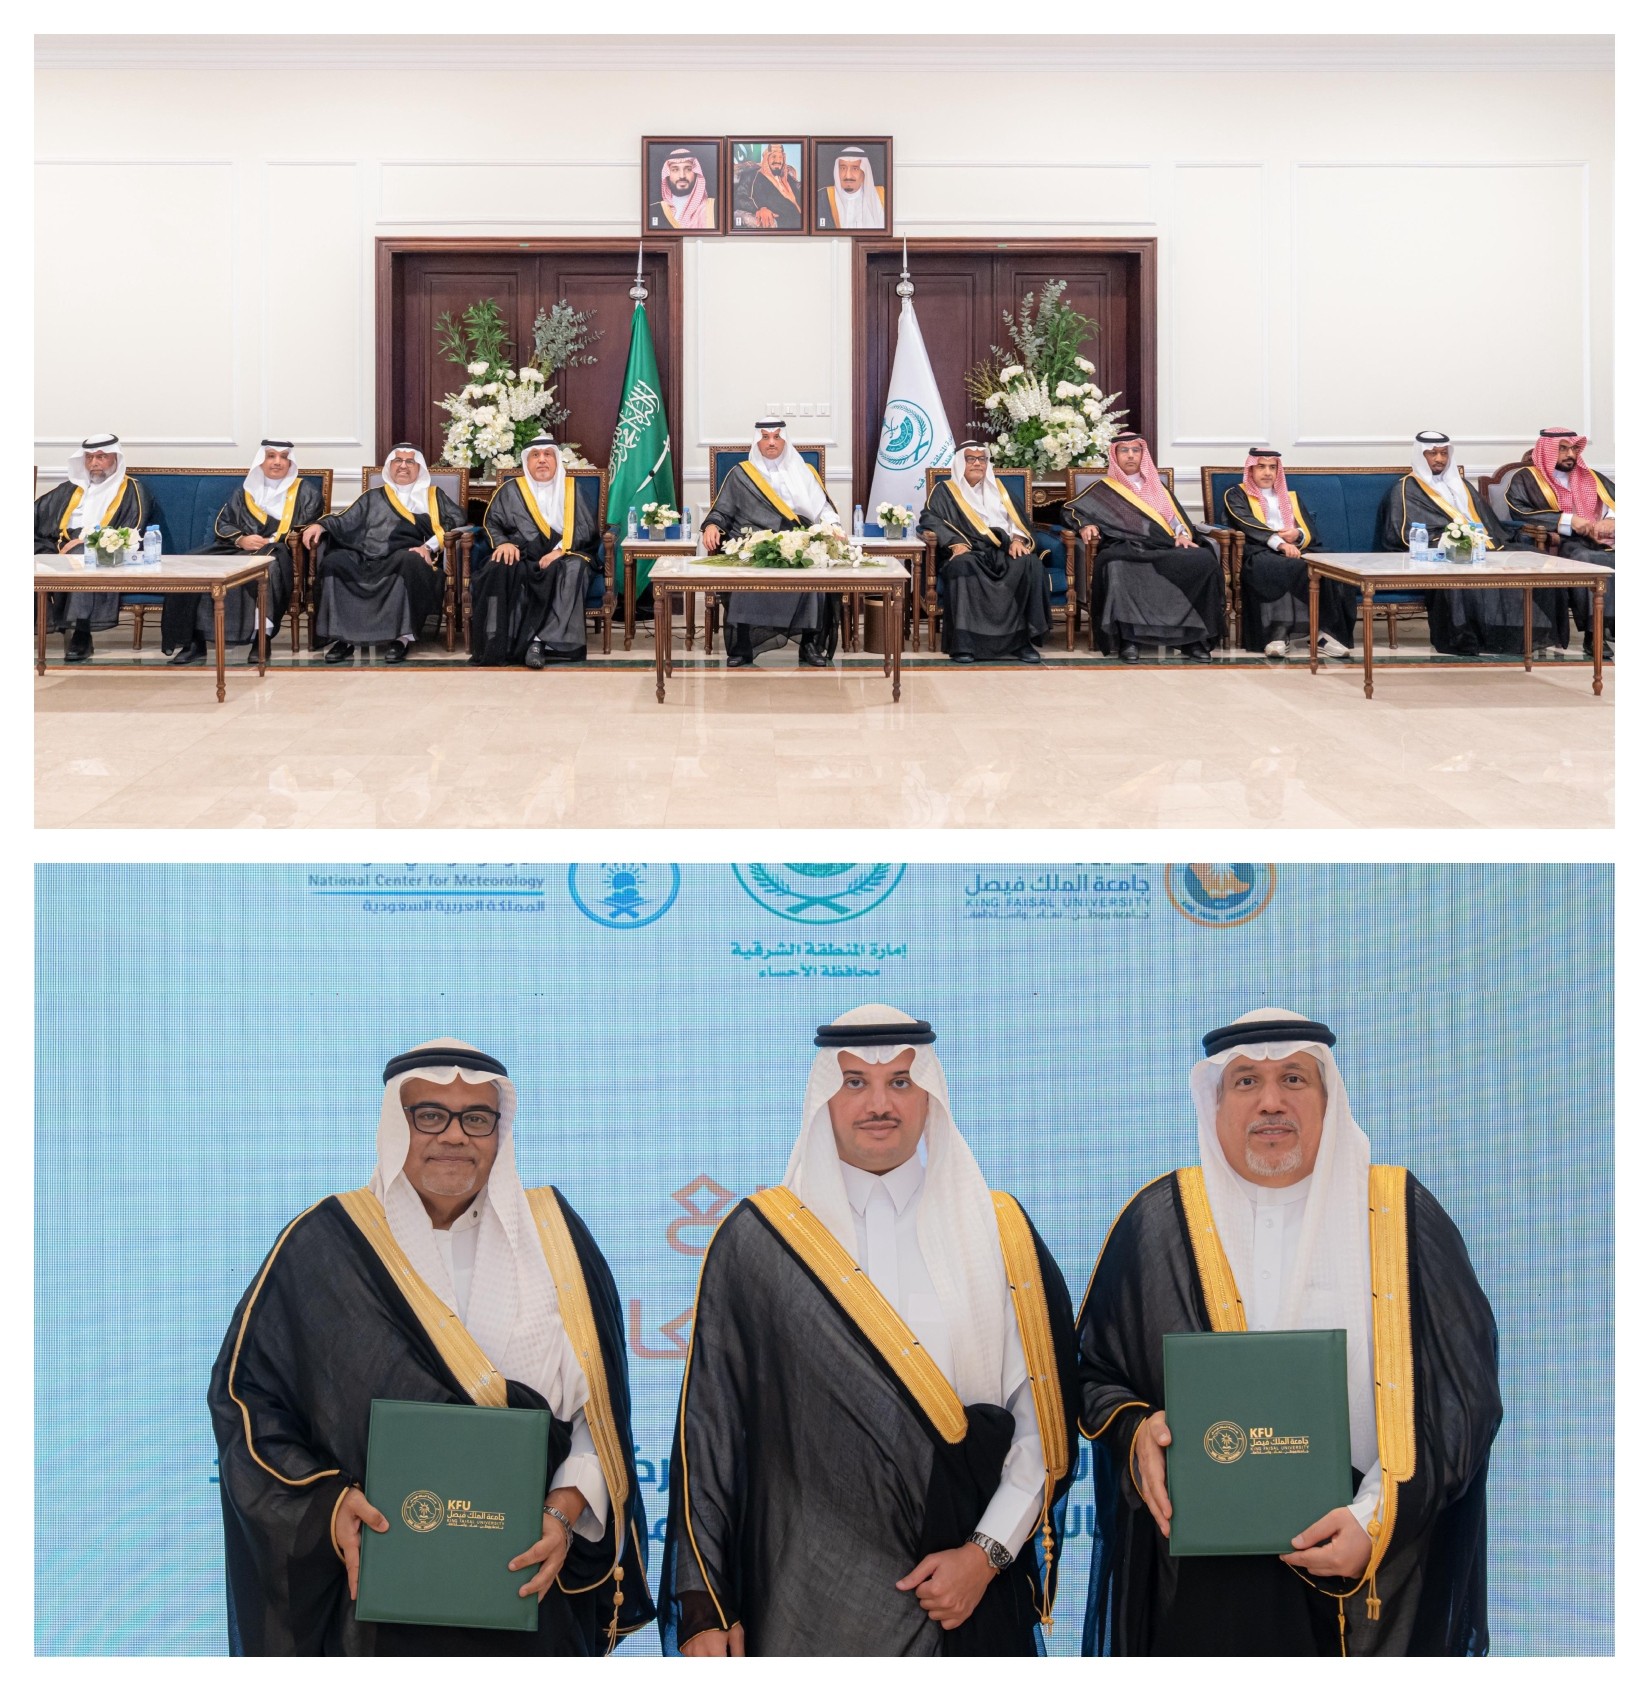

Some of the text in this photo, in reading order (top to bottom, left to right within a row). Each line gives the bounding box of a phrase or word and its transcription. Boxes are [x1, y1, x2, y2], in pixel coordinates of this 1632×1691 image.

[307, 874, 545, 890] National Center for Meteorology
[965, 873, 1150, 897] جامعة الملك فيصل
[363, 899, 546, 915] المملكة العربية السعودية
[965, 897, 1151, 907] KING FAISAL UNIVERSITY
[731, 941, 907, 960] إمارة المنطقة الشرقية
[821, 965, 881, 977] محافظة
[1250, 1427, 1273, 1438] KFU
[1250, 1437, 1309, 1447] جامعة الملك فيصل
[447, 1499, 471, 1511] KFU
[446, 1510, 505, 1521] جامعة الملك فيصل
